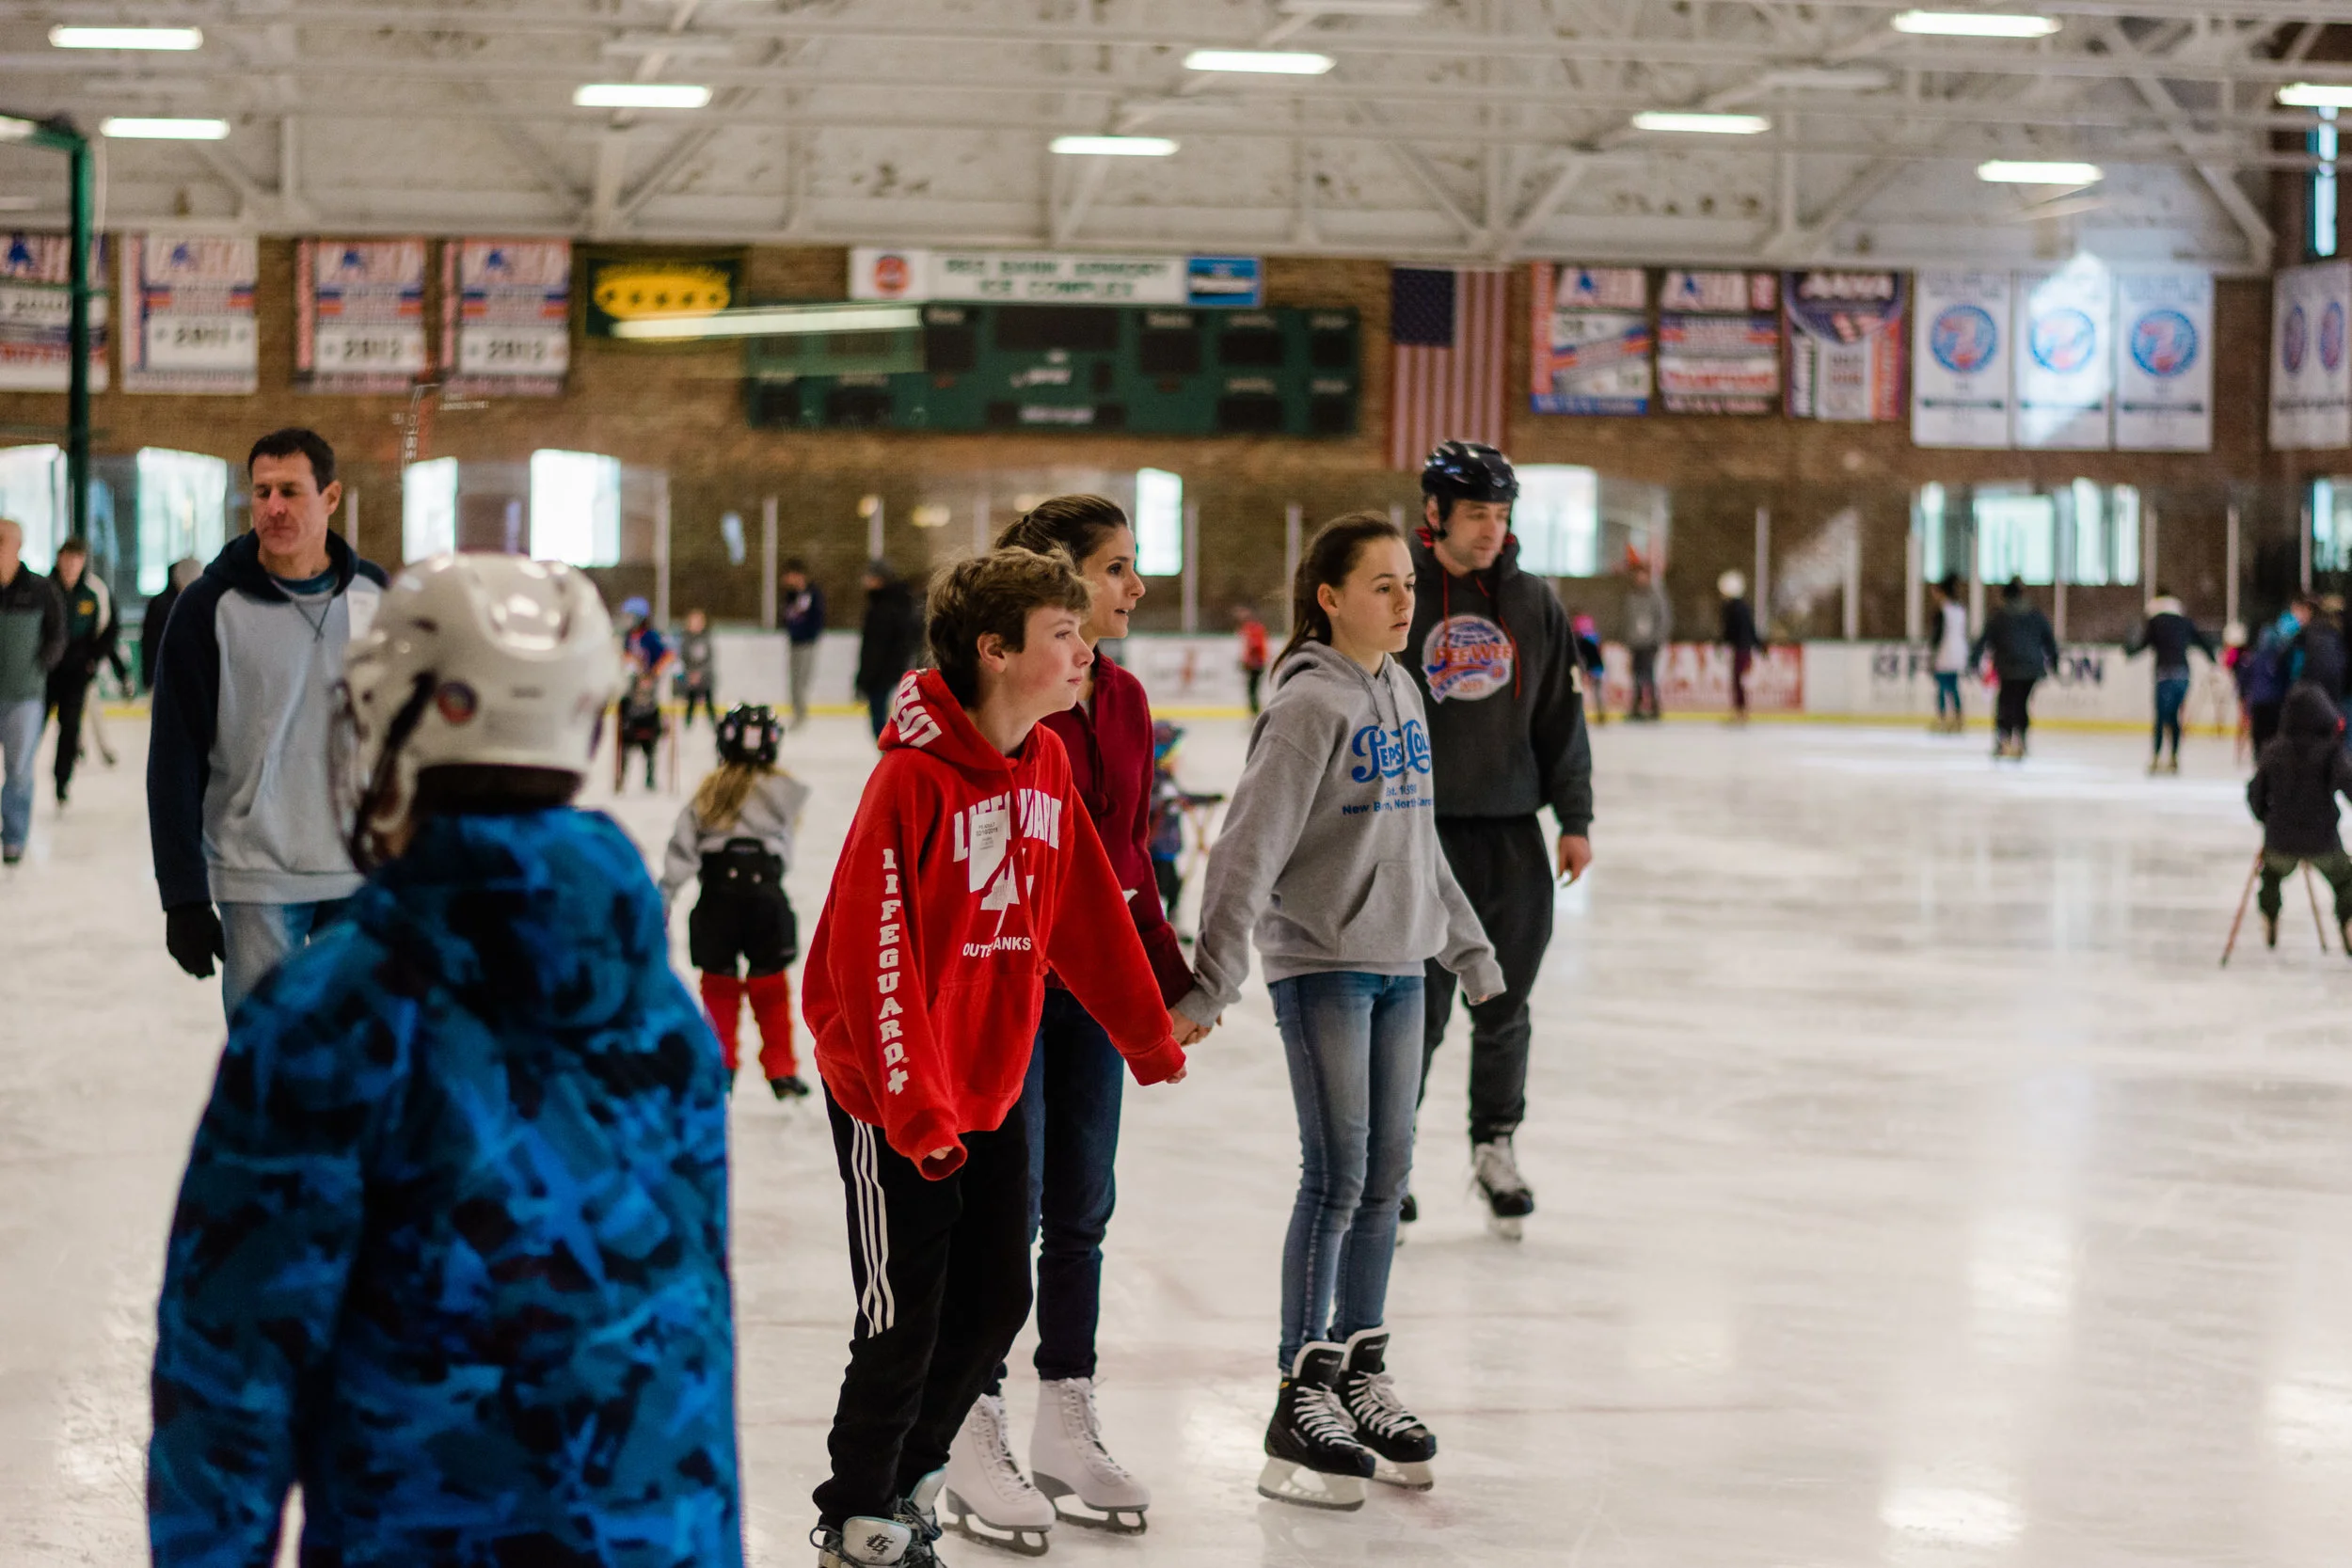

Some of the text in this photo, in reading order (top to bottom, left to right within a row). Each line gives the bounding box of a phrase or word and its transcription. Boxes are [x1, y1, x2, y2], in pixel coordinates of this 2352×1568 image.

[1342, 804, 1370, 815] New
[878, 848, 904, 1068] LIFEGUARD
[962, 937, 1031, 958] OUTE ANKS
